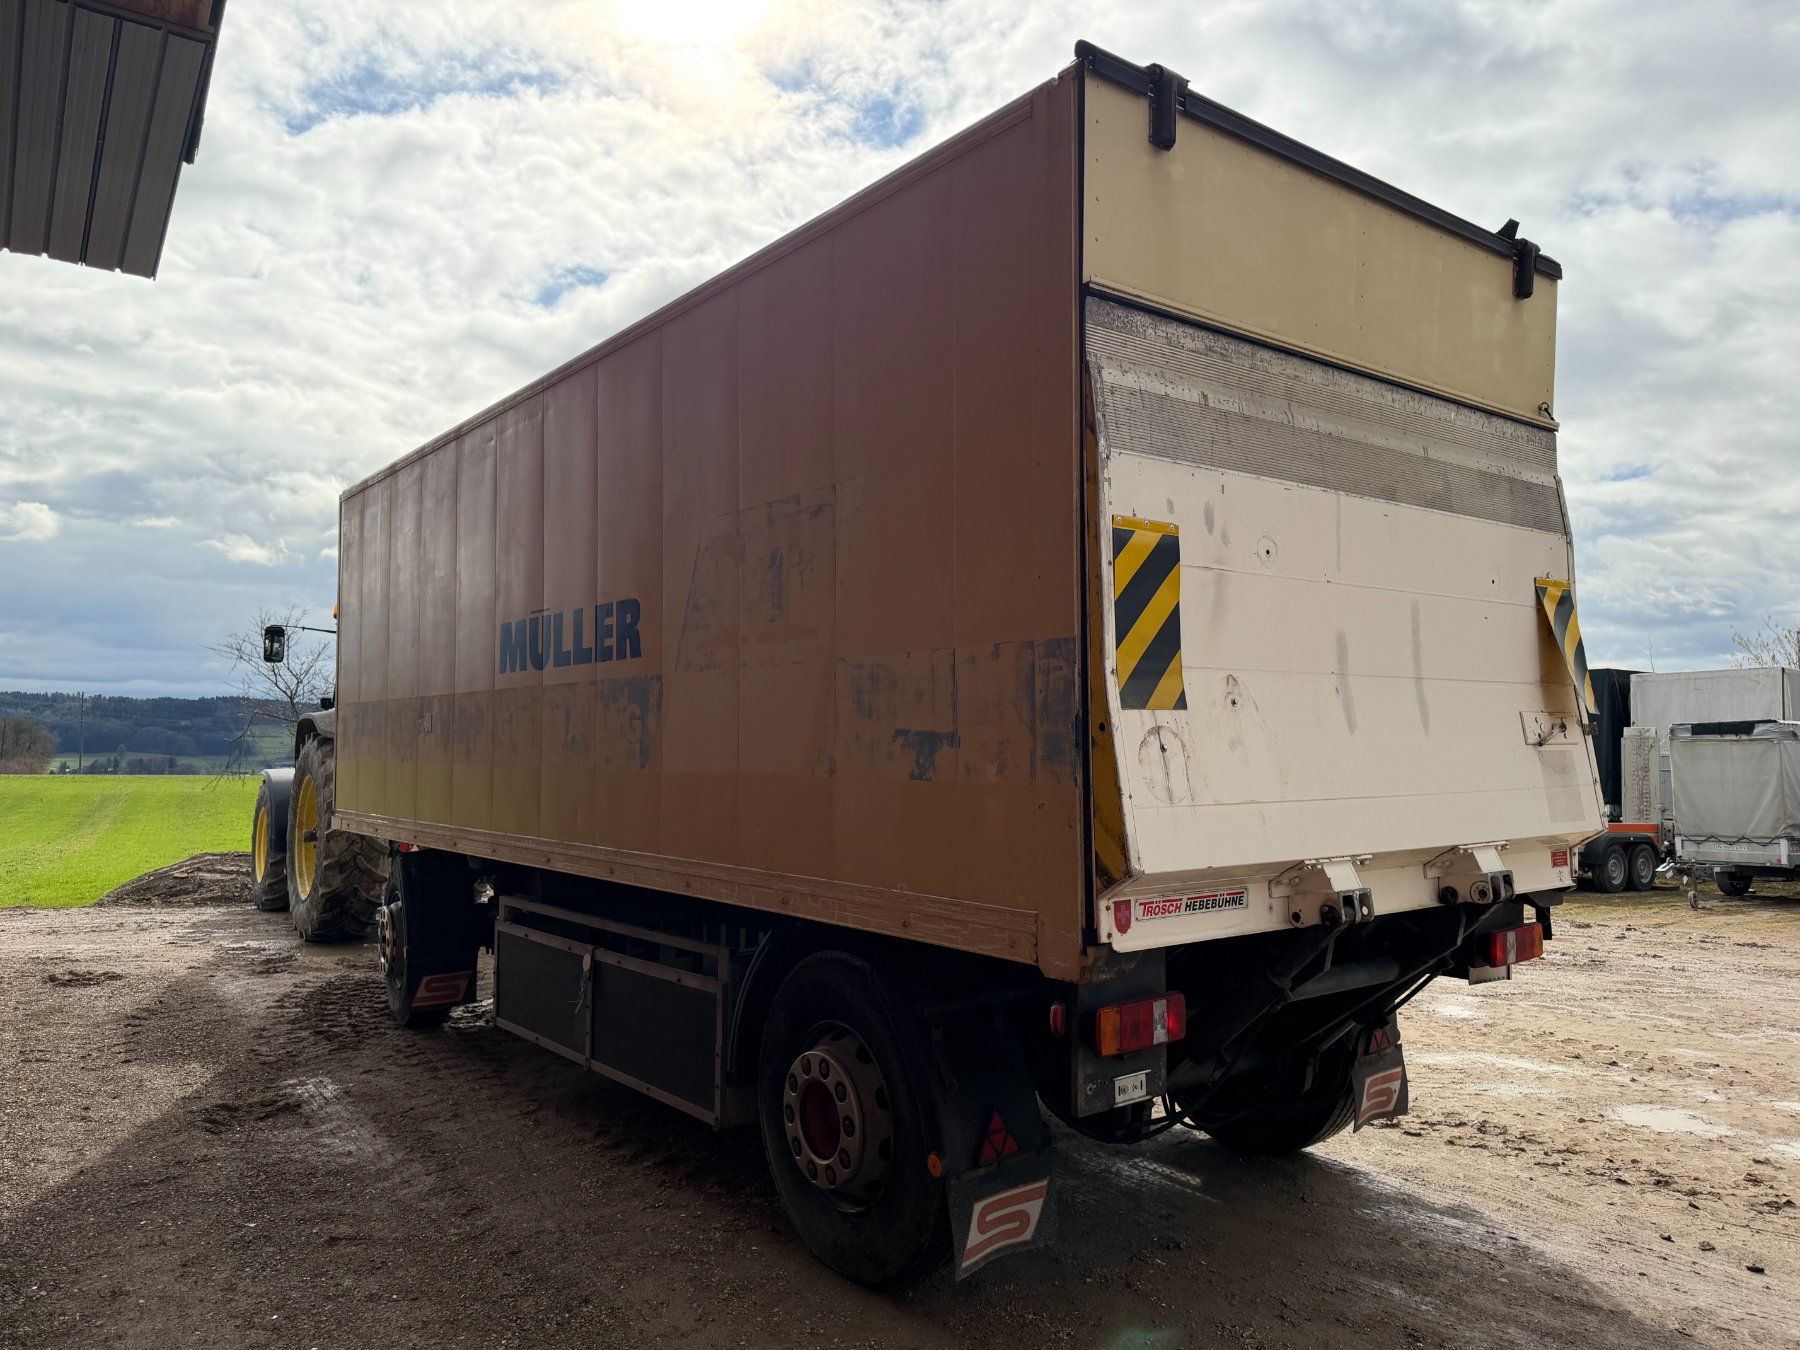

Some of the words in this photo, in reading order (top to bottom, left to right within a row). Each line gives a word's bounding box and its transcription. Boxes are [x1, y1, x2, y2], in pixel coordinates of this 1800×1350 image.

[499, 598, 642, 674] MÜLLER
[1139, 898, 1183, 917] TRÖSCH
[1185, 892, 1244, 912] HEBEBÜHNE
